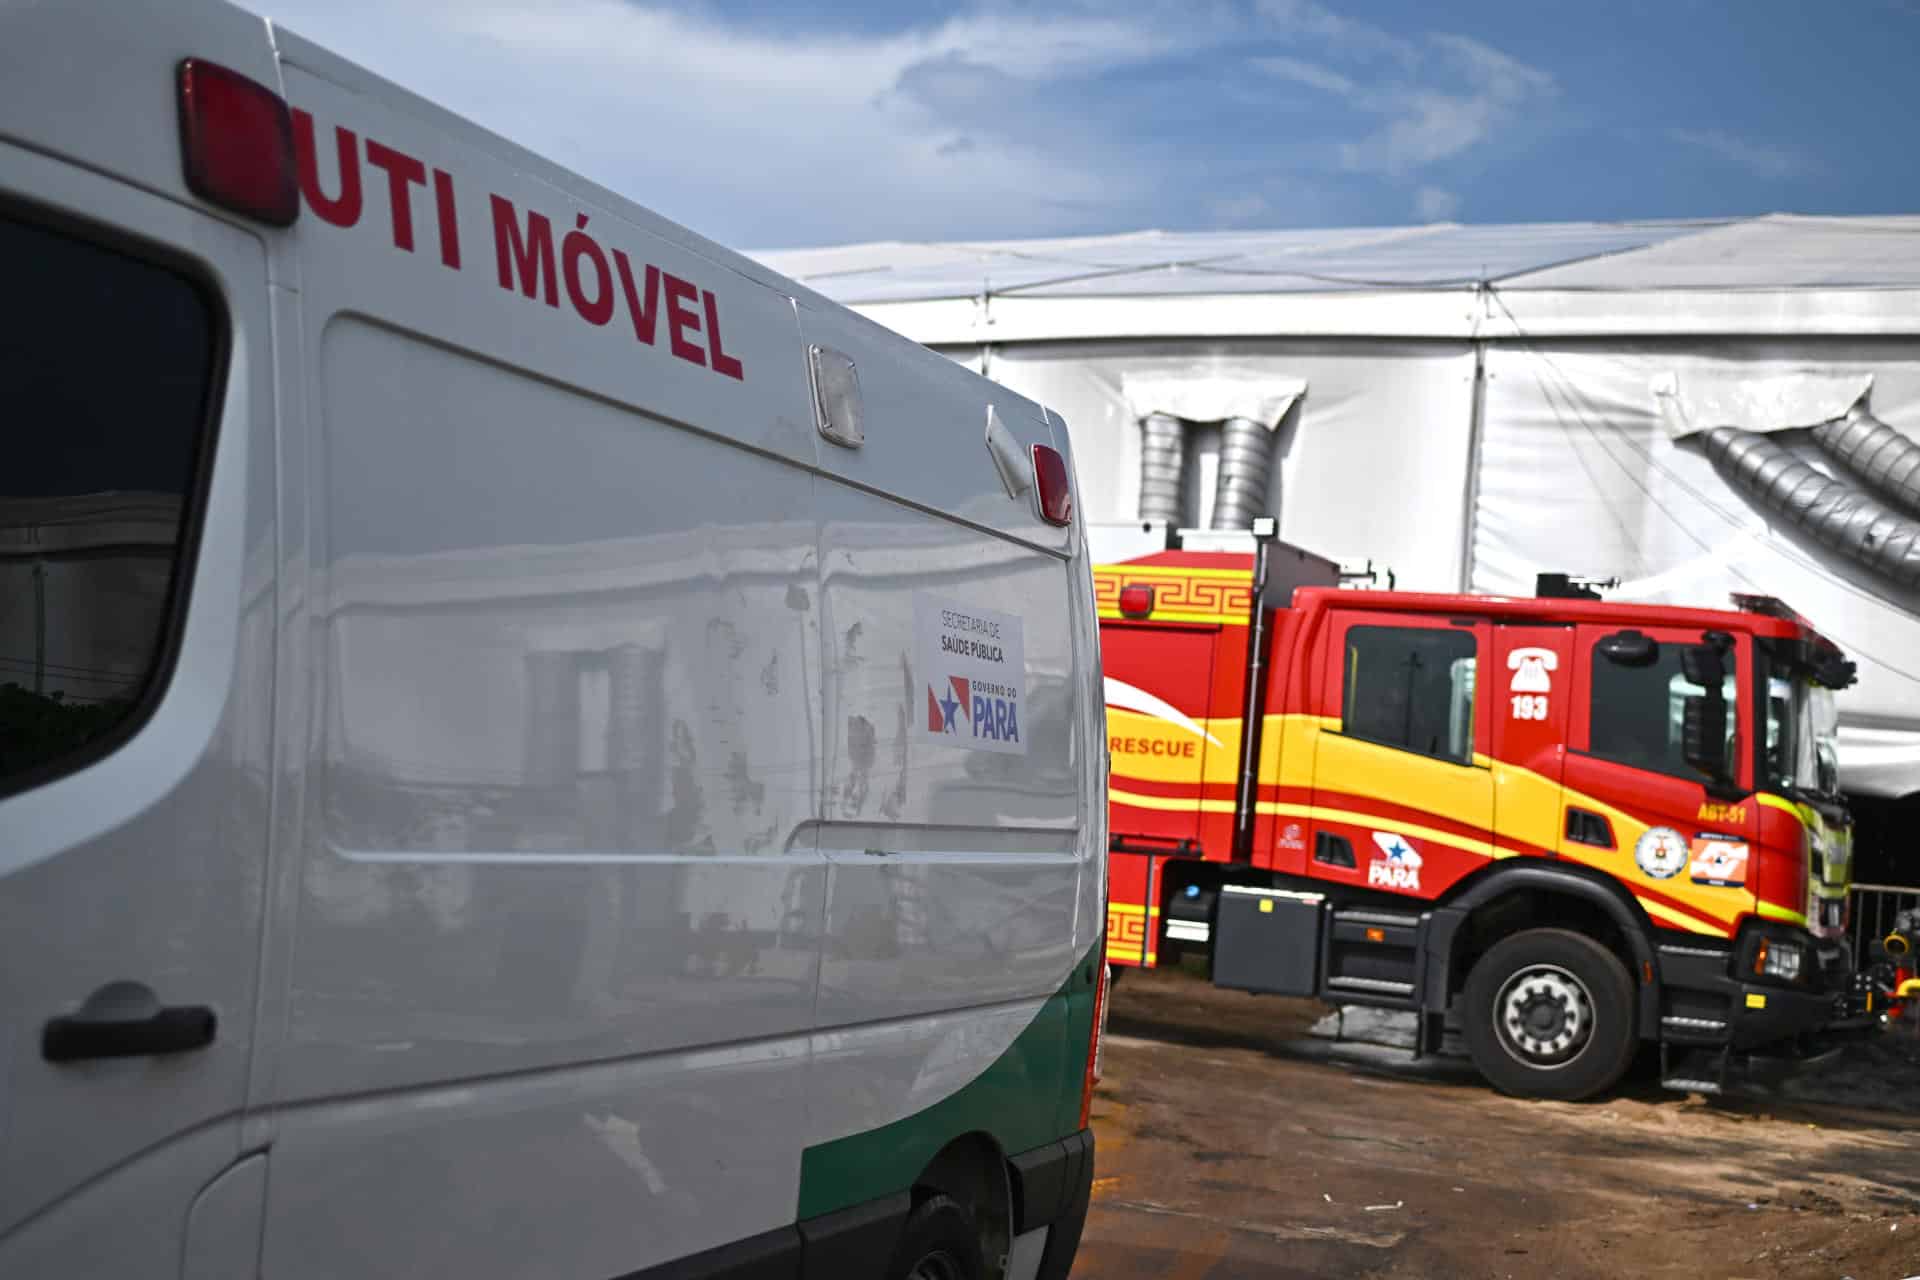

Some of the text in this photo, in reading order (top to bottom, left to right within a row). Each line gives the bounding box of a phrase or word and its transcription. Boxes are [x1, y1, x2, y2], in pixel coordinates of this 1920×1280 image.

[291, 107, 743, 381] UTI MÓVEL
[942, 610, 1000, 639] SECRETARIA DE
[942, 634, 1004, 663] SAÚDE PÚBLICA
[972, 681, 1017, 699] GOVERNO DO
[1511, 695, 1548, 720] 193
[1110, 737, 1195, 758] RESCUE
